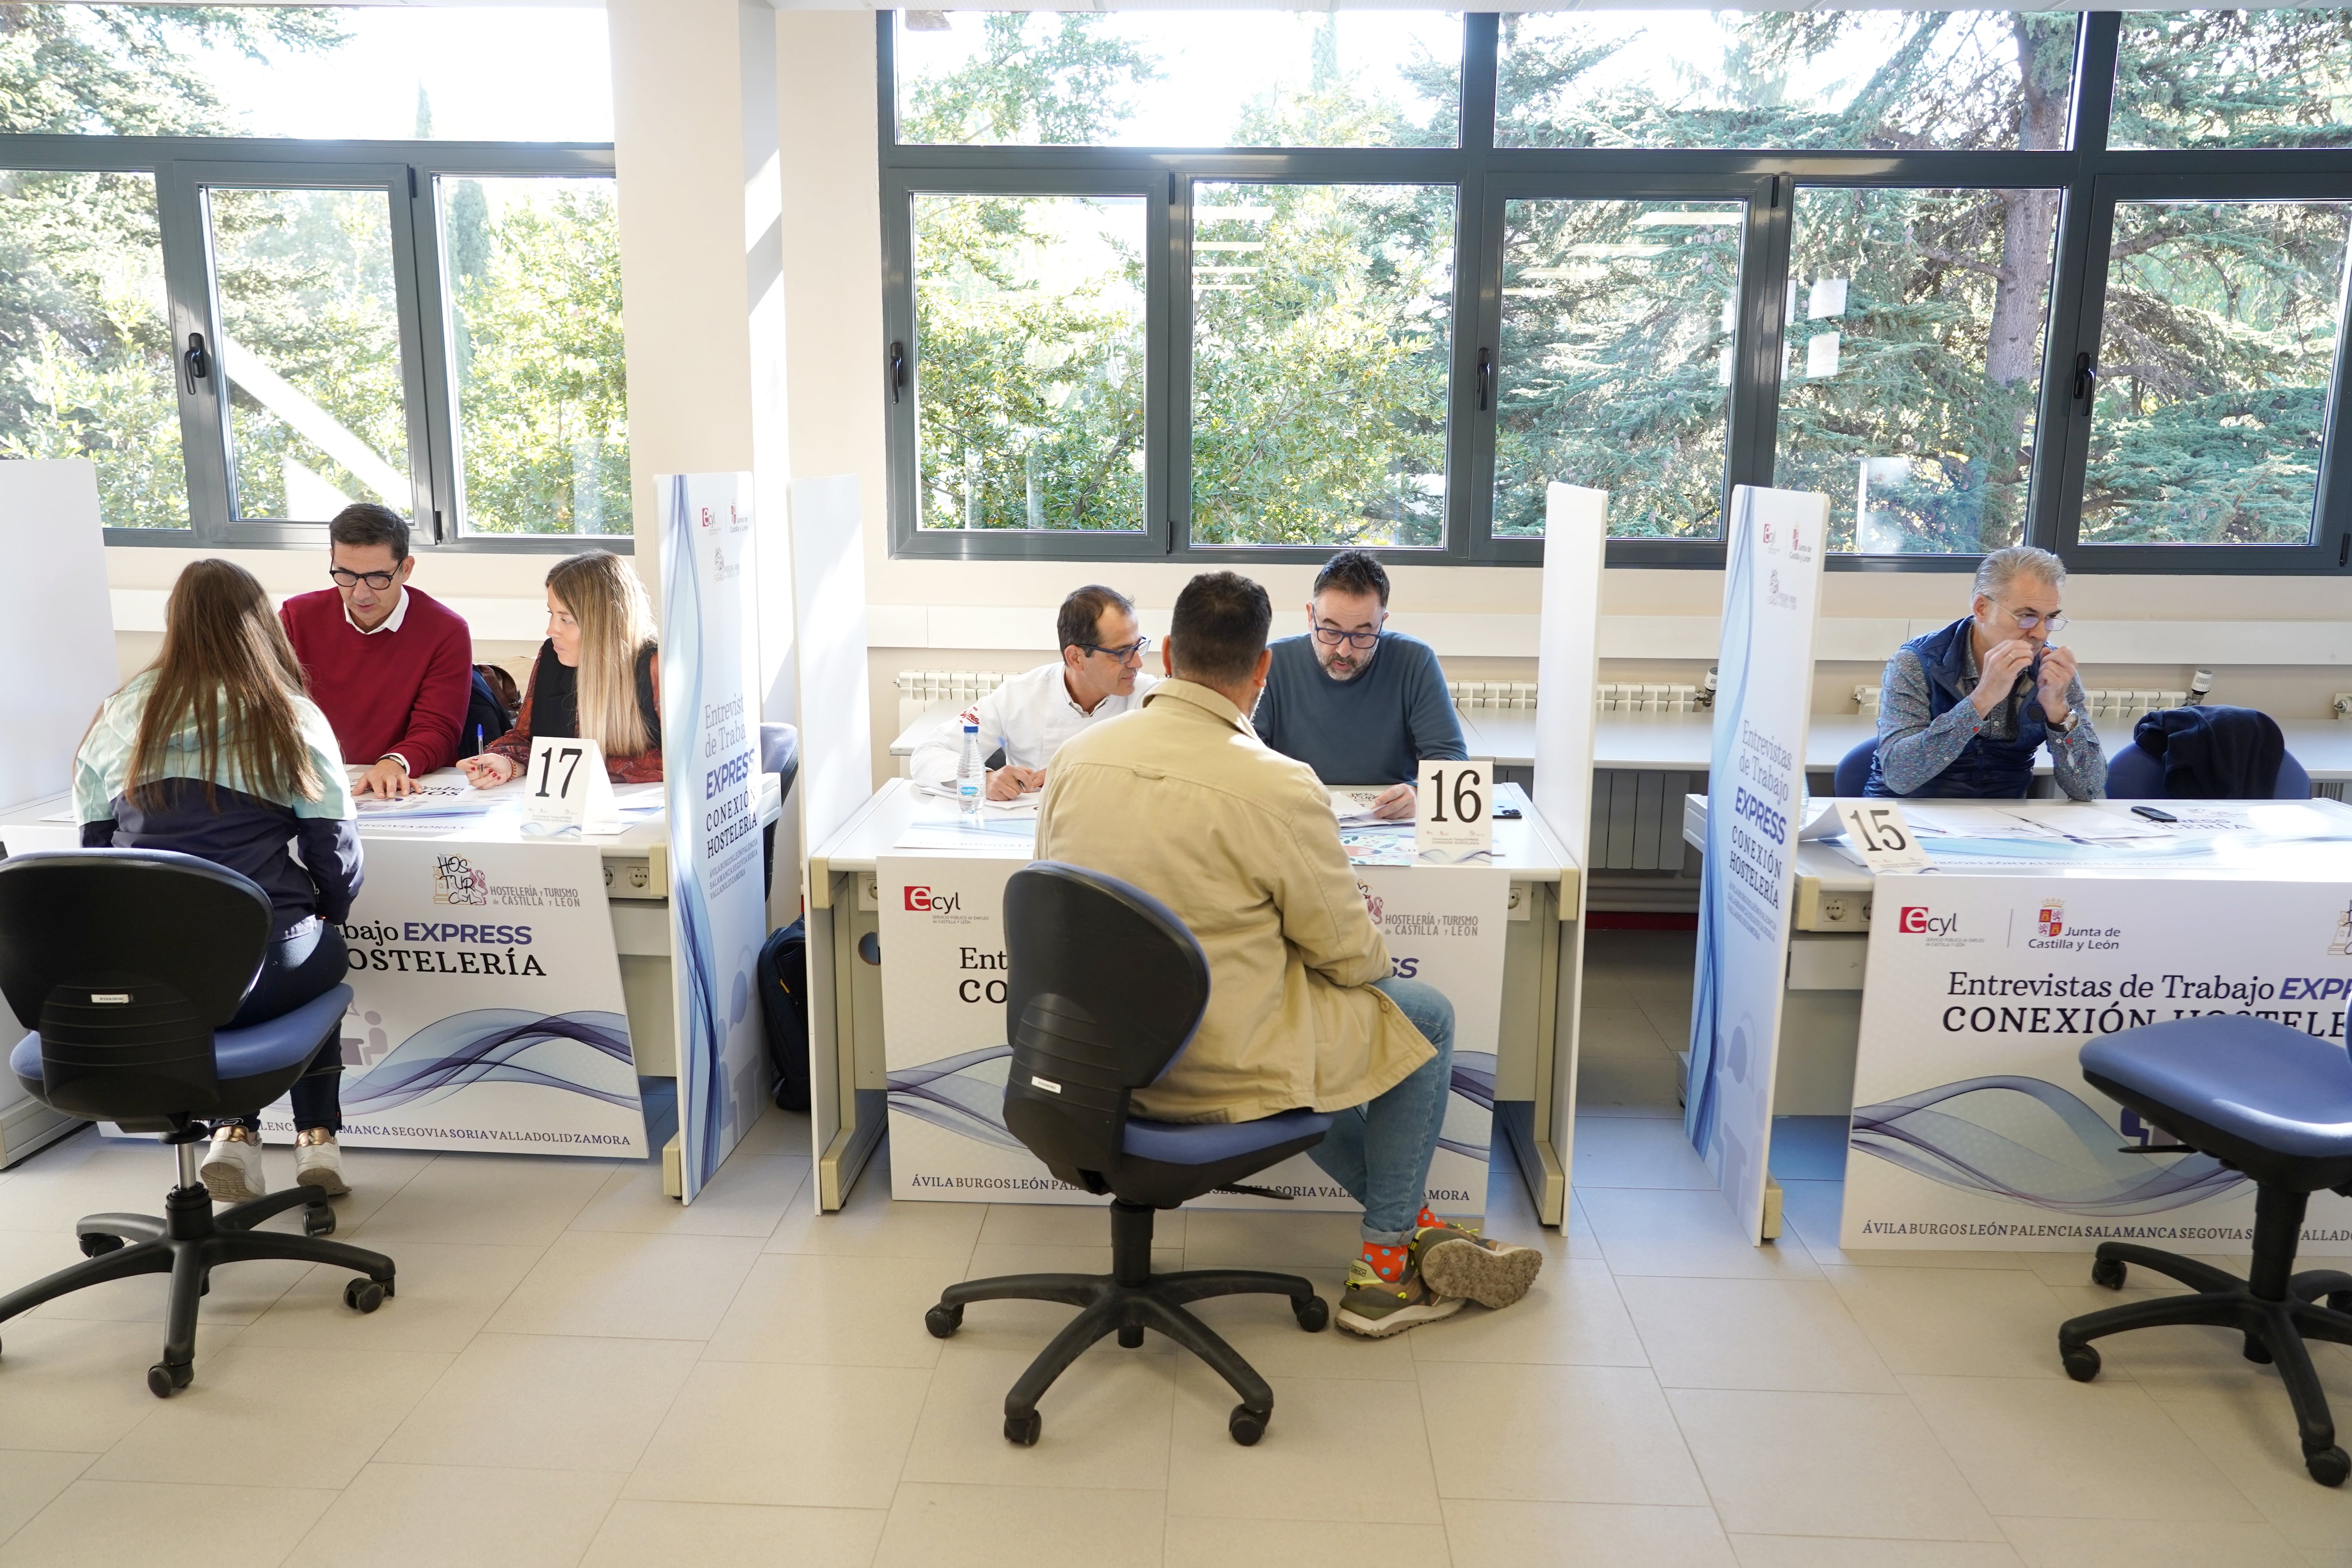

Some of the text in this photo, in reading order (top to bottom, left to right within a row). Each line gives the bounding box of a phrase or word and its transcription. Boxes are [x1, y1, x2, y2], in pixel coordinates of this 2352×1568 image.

[705, 693, 744, 729] Entrevist
[706, 720, 747, 758] de Traba
[1742, 720, 1792, 771] Entrevistas
[535, 747, 582, 799] 17
[707, 748, 755, 800] EXPRESS
[1740, 748, 1788, 805] de Trabajo
[707, 786, 755, 832] CONEXIÓN
[1430, 769, 1481, 823] 16
[1735, 786, 1786, 845] EXPRESS
[1850, 810, 1906, 851] 15
[707, 809, 757, 859] HOSTELERÍA
[437, 856, 468, 875] HOS
[1732, 826, 1782, 880] CONEXIÓN
[439, 875, 475, 893] TUR
[490, 885, 537, 896] HOSTELERÍA
[543, 888, 578, 898] TURISMO
[1730, 851, 1778, 909] HOSTELERÍA
[502, 896, 544, 906] CASTILLA
[909, 886, 961, 914] ecyl
[340, 921, 532, 946] bajo EXPRESS
[1385, 913, 1435, 925] HOSTELERÍA
[1442, 915, 1478, 926] TURISMO
[1395, 925, 1438, 936] CASTILLA
[1903, 907, 1957, 936] ecyl
[2065, 927, 2121, 938] Junta de
[2028, 939, 2120, 952] Castilla y León
[349, 947, 547, 976] OSTELERÍA
[1947, 972, 2112, 998] Entrevistas
[2120, 973, 2154, 998] de
[2162, 975, 2274, 1007] Trabajo
[1943, 1001, 2156, 1034] CONEXIÓN
[260, 1121, 631, 1146] LENC AMANCA SEGOVIA SORIA VALLADOLID ZAMORA
[912, 1174, 954, 1187] ÁVILA
[956, 1178, 1010, 1189] BURGOS
[1013, 1177, 1049, 1190] LEÓN
[1275, 1186, 1317, 1197] SORIA
[1423, 1190, 1470, 1200] MORA
[1862, 1220, 1907, 1234] ÁVILA
[1909, 1223, 1968, 1235] BURGOS
[1969, 1222, 2008, 1236] LEÓN
[2010, 1225, 2083, 1237] PALENCIA
[2085, 1226, 2177, 1239] SALAMANCA
[2179, 1227, 2243, 1240] SEGOVIA
[2300, 1229, 2352, 1241] ALLAD
